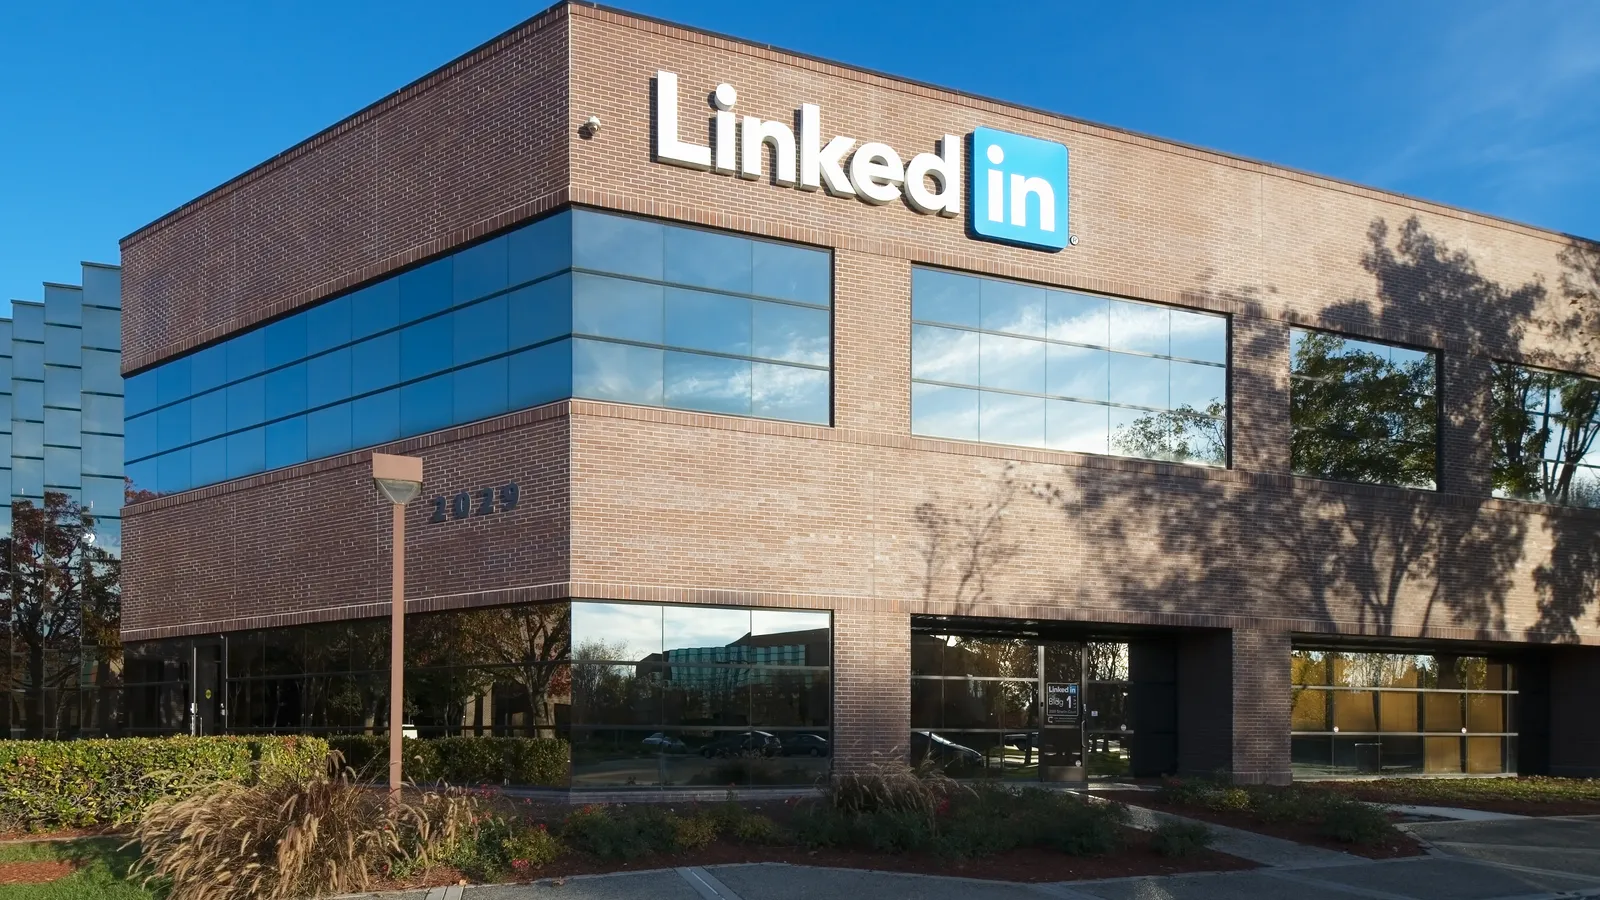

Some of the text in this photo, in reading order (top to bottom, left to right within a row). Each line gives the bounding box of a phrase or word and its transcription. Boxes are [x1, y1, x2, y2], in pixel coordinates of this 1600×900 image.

[656, 69, 1056, 233] Linked in
[432, 482, 520, 523] 2029
[1066, 696, 1072, 708] 1
